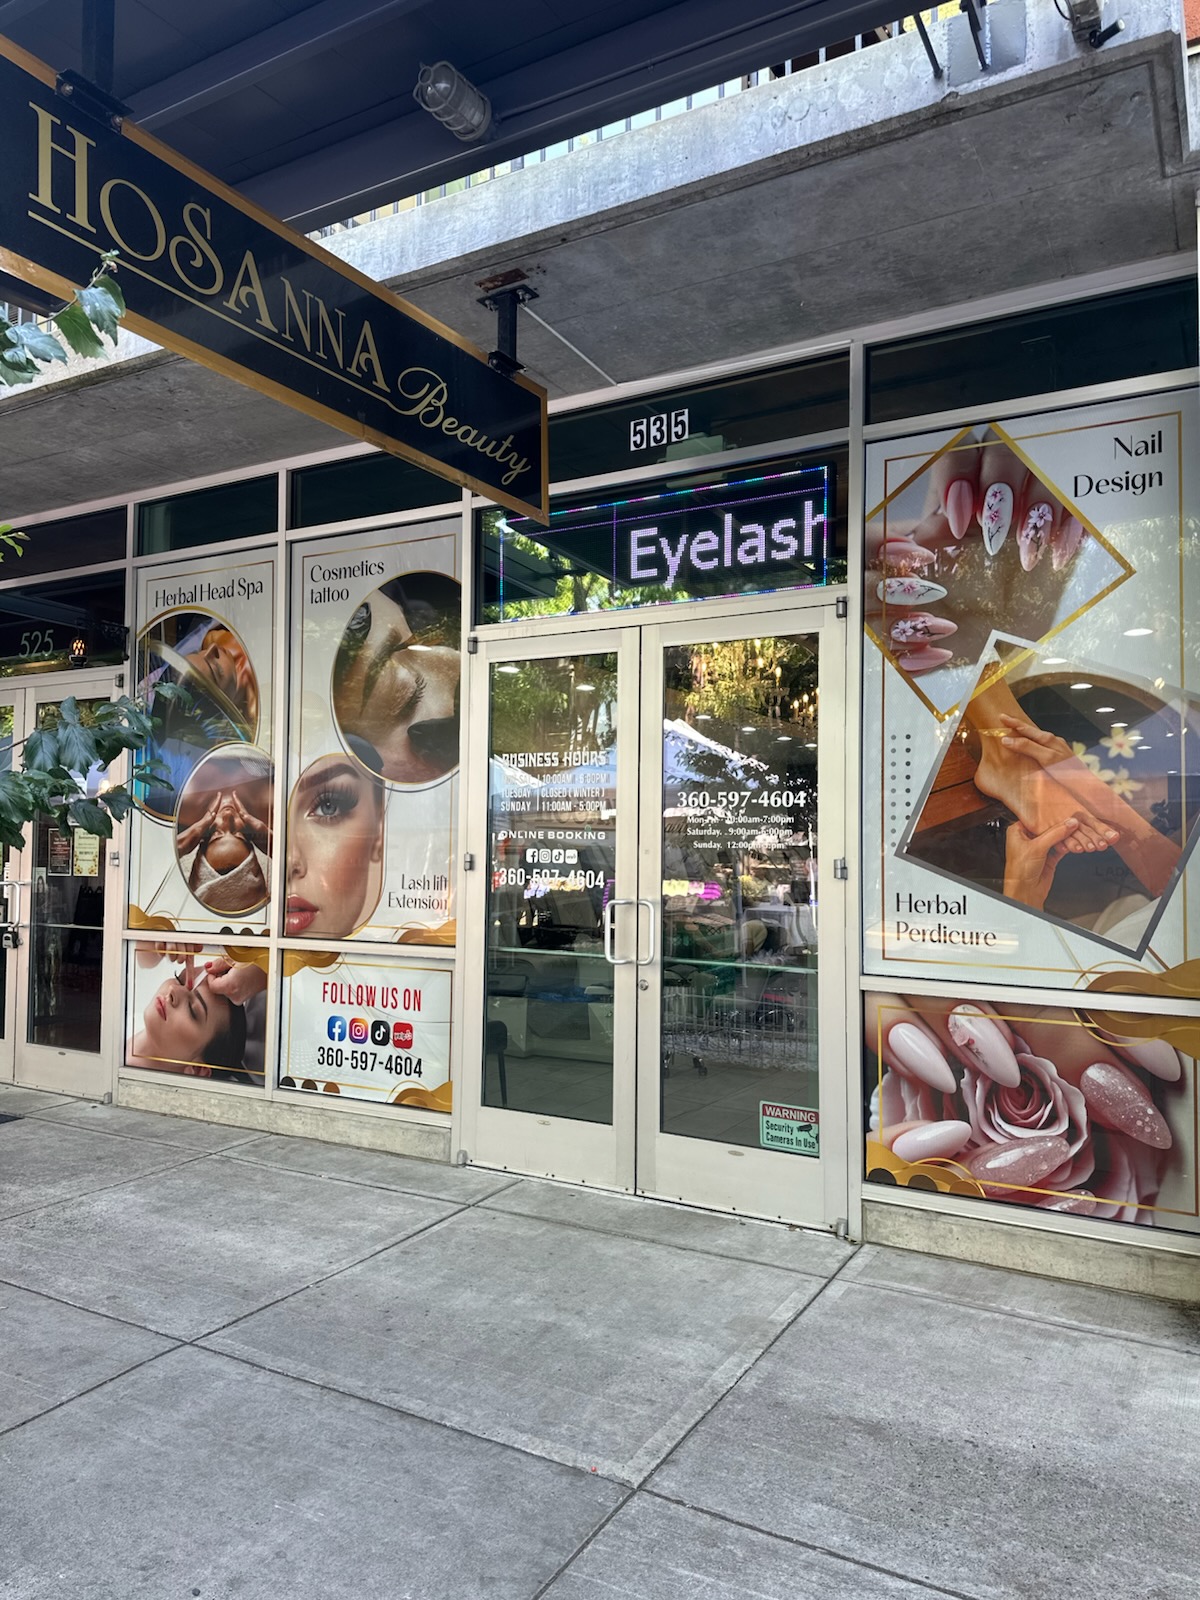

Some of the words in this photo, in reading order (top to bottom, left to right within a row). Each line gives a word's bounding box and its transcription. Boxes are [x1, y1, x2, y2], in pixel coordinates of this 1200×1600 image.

[28, 101, 391, 393] HOSANNA
[397, 366, 532, 486] Beauty
[631, 408, 688, 450] 535
[1113, 430, 1162, 460] Nail
[1073, 470, 1163, 498] Design
[630, 500, 826, 589] Eyelash
[310, 560, 385, 584] Cosmetics
[155, 584, 197, 608] Herbal
[200, 579, 235, 602] Head
[237, 577, 264, 600] Spa
[310, 585, 350, 605] tattoo
[19, 629, 54, 658] 525
[502, 752, 560, 768] BUSINESS
[563, 750, 607, 767] HOURS
[501, 788, 531, 798] TUESDAY
[541, 787, 568, 798] CLOSED
[573, 787, 600, 798] WINTER
[677, 790, 807, 808] 360-597-4604
[500, 801, 531, 811] SUNDAY
[541, 801, 572, 811] 11:00AM
[579, 801, 607, 811] 5:00PM
[500, 830, 545, 840] ONLINE
[547, 831, 606, 840] BOOKING
[686, 827, 722, 837] Saturday.
[693, 840, 722, 850] Sunday.
[401, 873, 430, 891] Lash
[433, 874, 448, 891] lift
[388, 891, 448, 910] Extension
[896, 892, 967, 916] Herbal
[896, 920, 997, 947] Perdicure
[322, 981, 377, 1008] FOLLOW
[381, 986, 399, 1010] US
[403, 987, 422, 1012] ON
[317, 1046, 423, 1078] 360-597-4604
[764, 1105, 816, 1123] WARNING
[765, 1120, 794, 1135] Security
[766, 1131, 794, 1146] Cameras
[795, 1136, 802, 1147] In
[803, 1137, 816, 1149] Use
